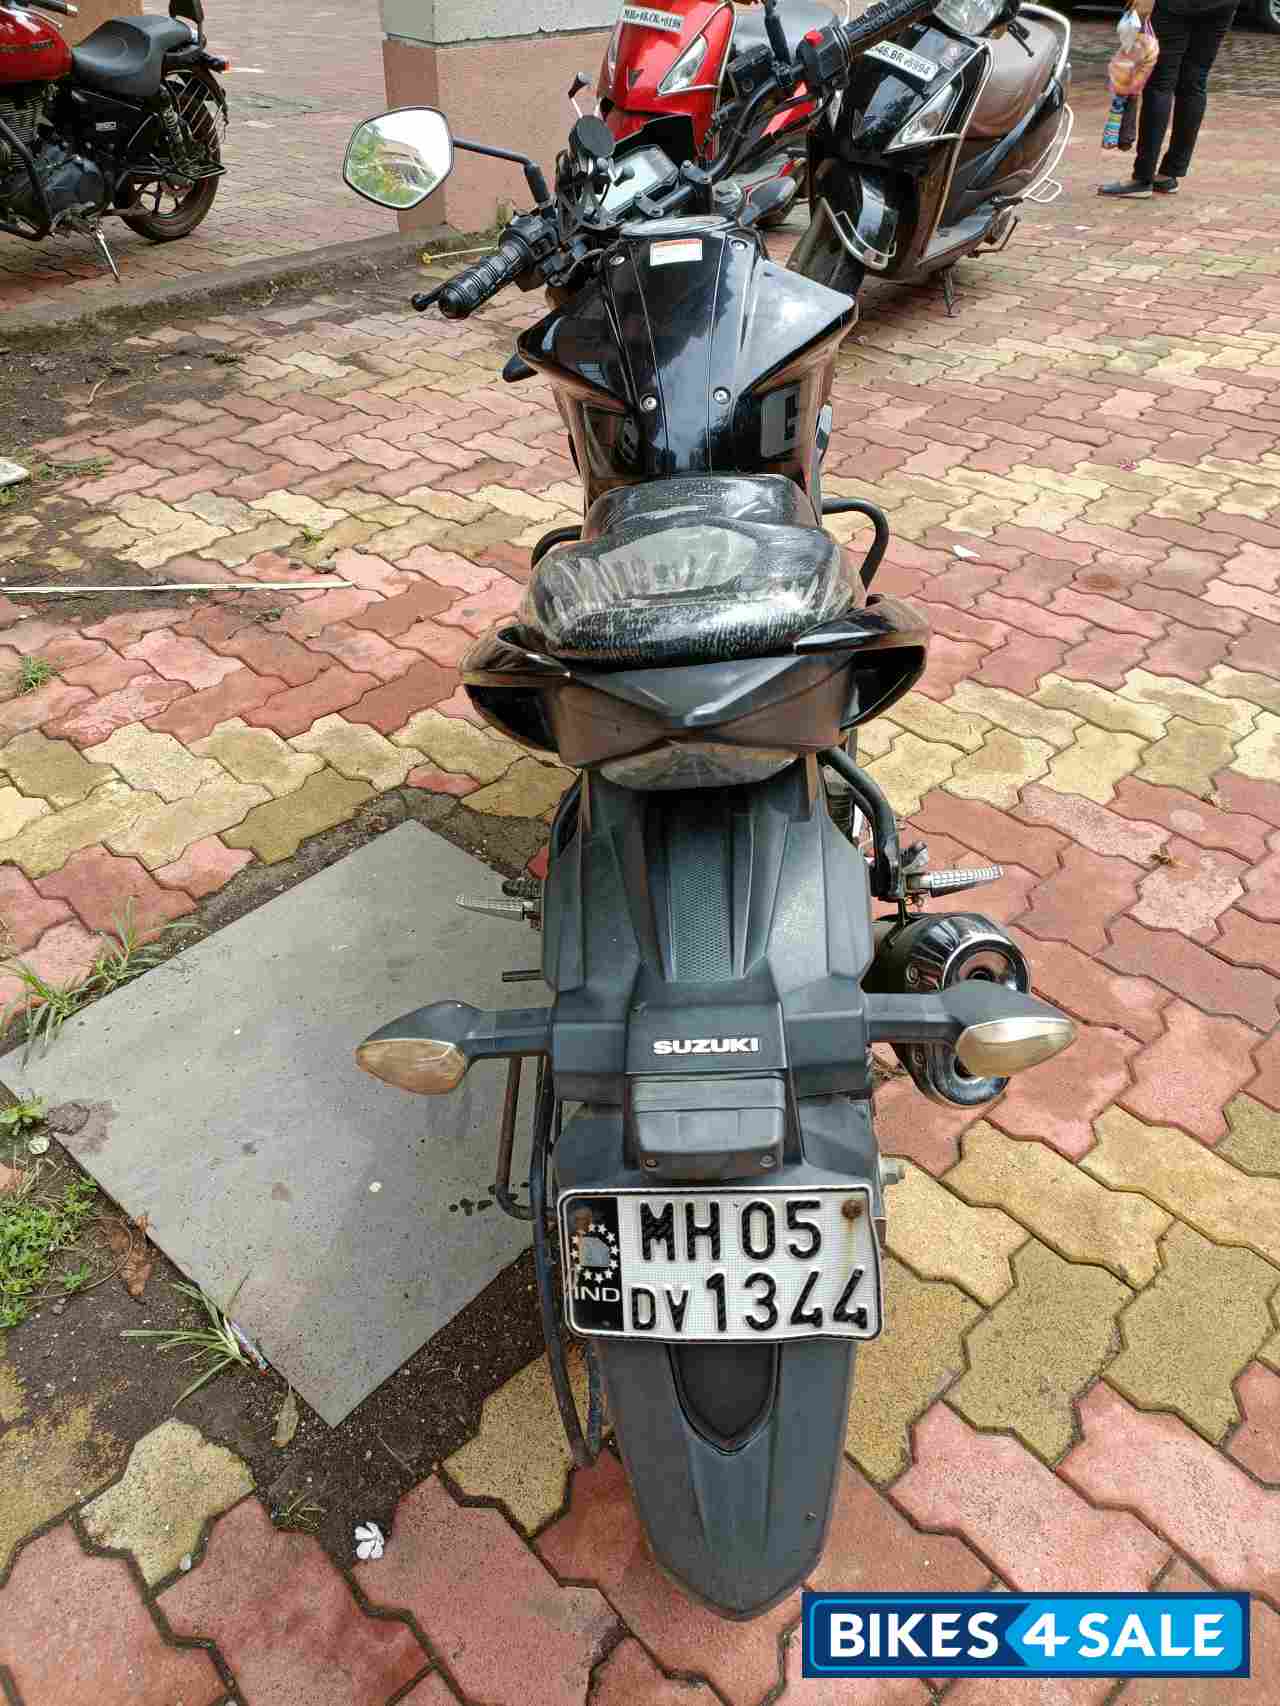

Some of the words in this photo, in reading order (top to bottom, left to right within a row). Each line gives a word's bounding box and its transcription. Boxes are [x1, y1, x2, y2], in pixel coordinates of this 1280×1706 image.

[653, 1038, 759, 1055] SUZUKI
[639, 1200, 721, 1261] MH
[741, 1200, 822, 1260] 05
[574, 1286, 621, 1303] IND
[631, 1286, 689, 1332] DV
[706, 1268, 868, 1332] 1344
